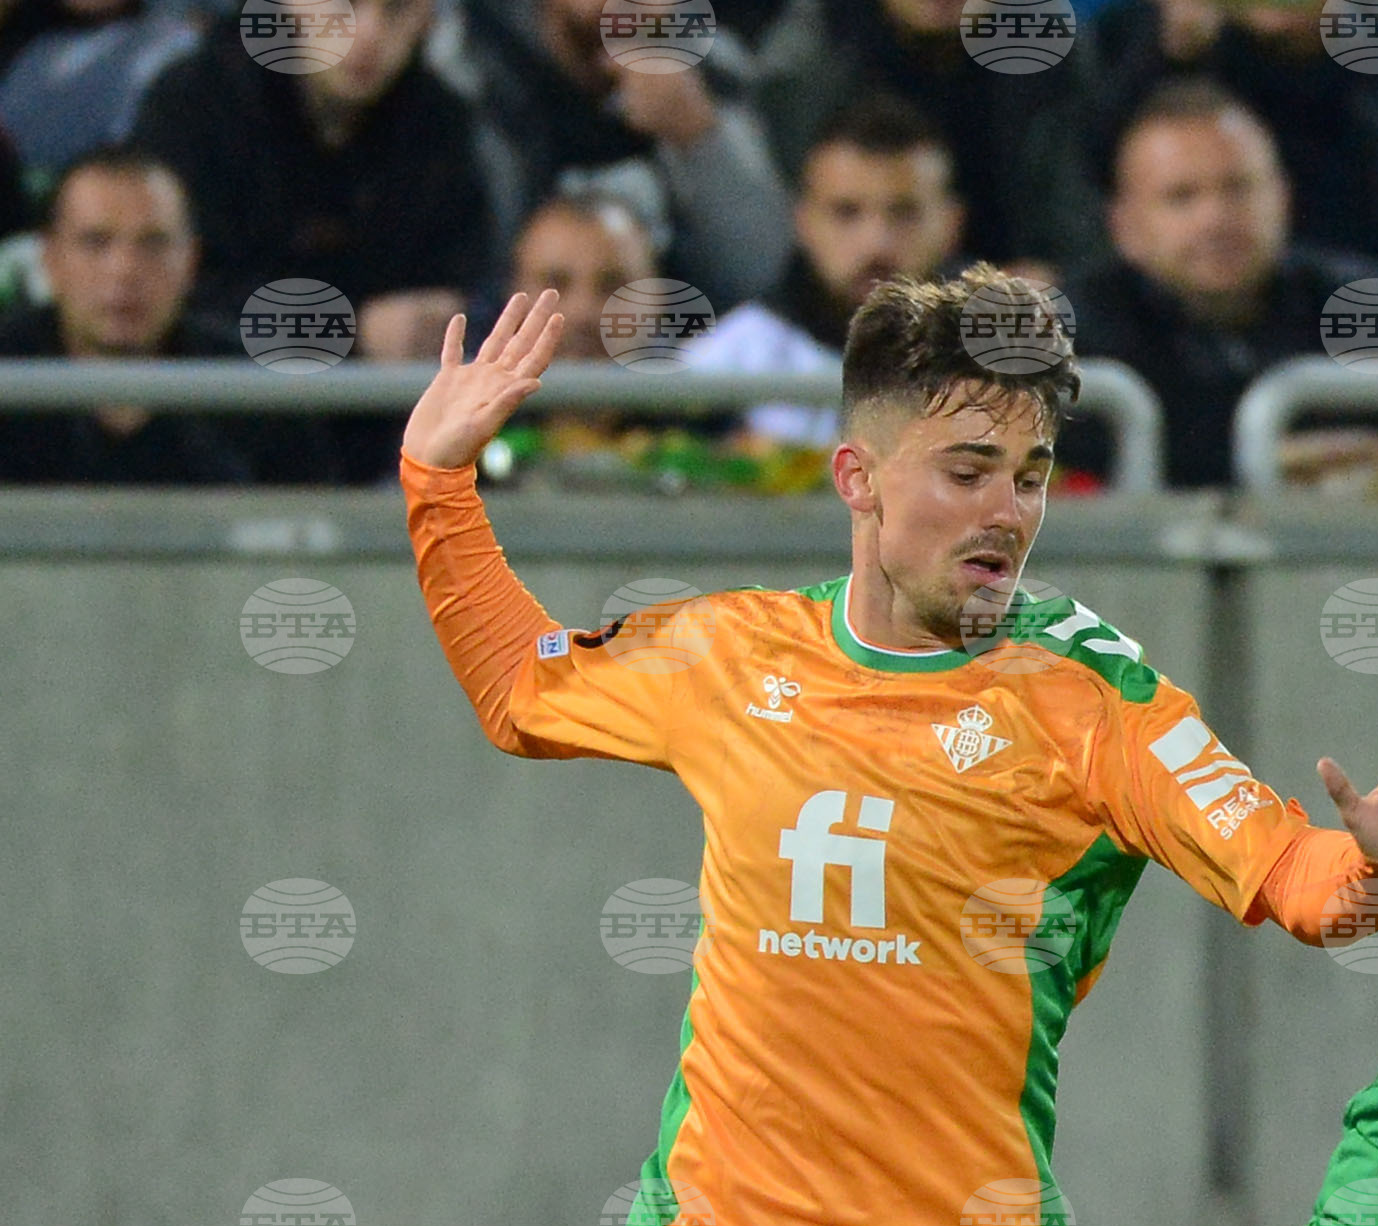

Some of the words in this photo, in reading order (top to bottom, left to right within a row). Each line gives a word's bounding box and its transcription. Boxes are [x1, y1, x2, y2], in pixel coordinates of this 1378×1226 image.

[744, 702, 794, 724] hummel
[778, 789, 895, 929] fi
[758, 928, 922, 964] network
